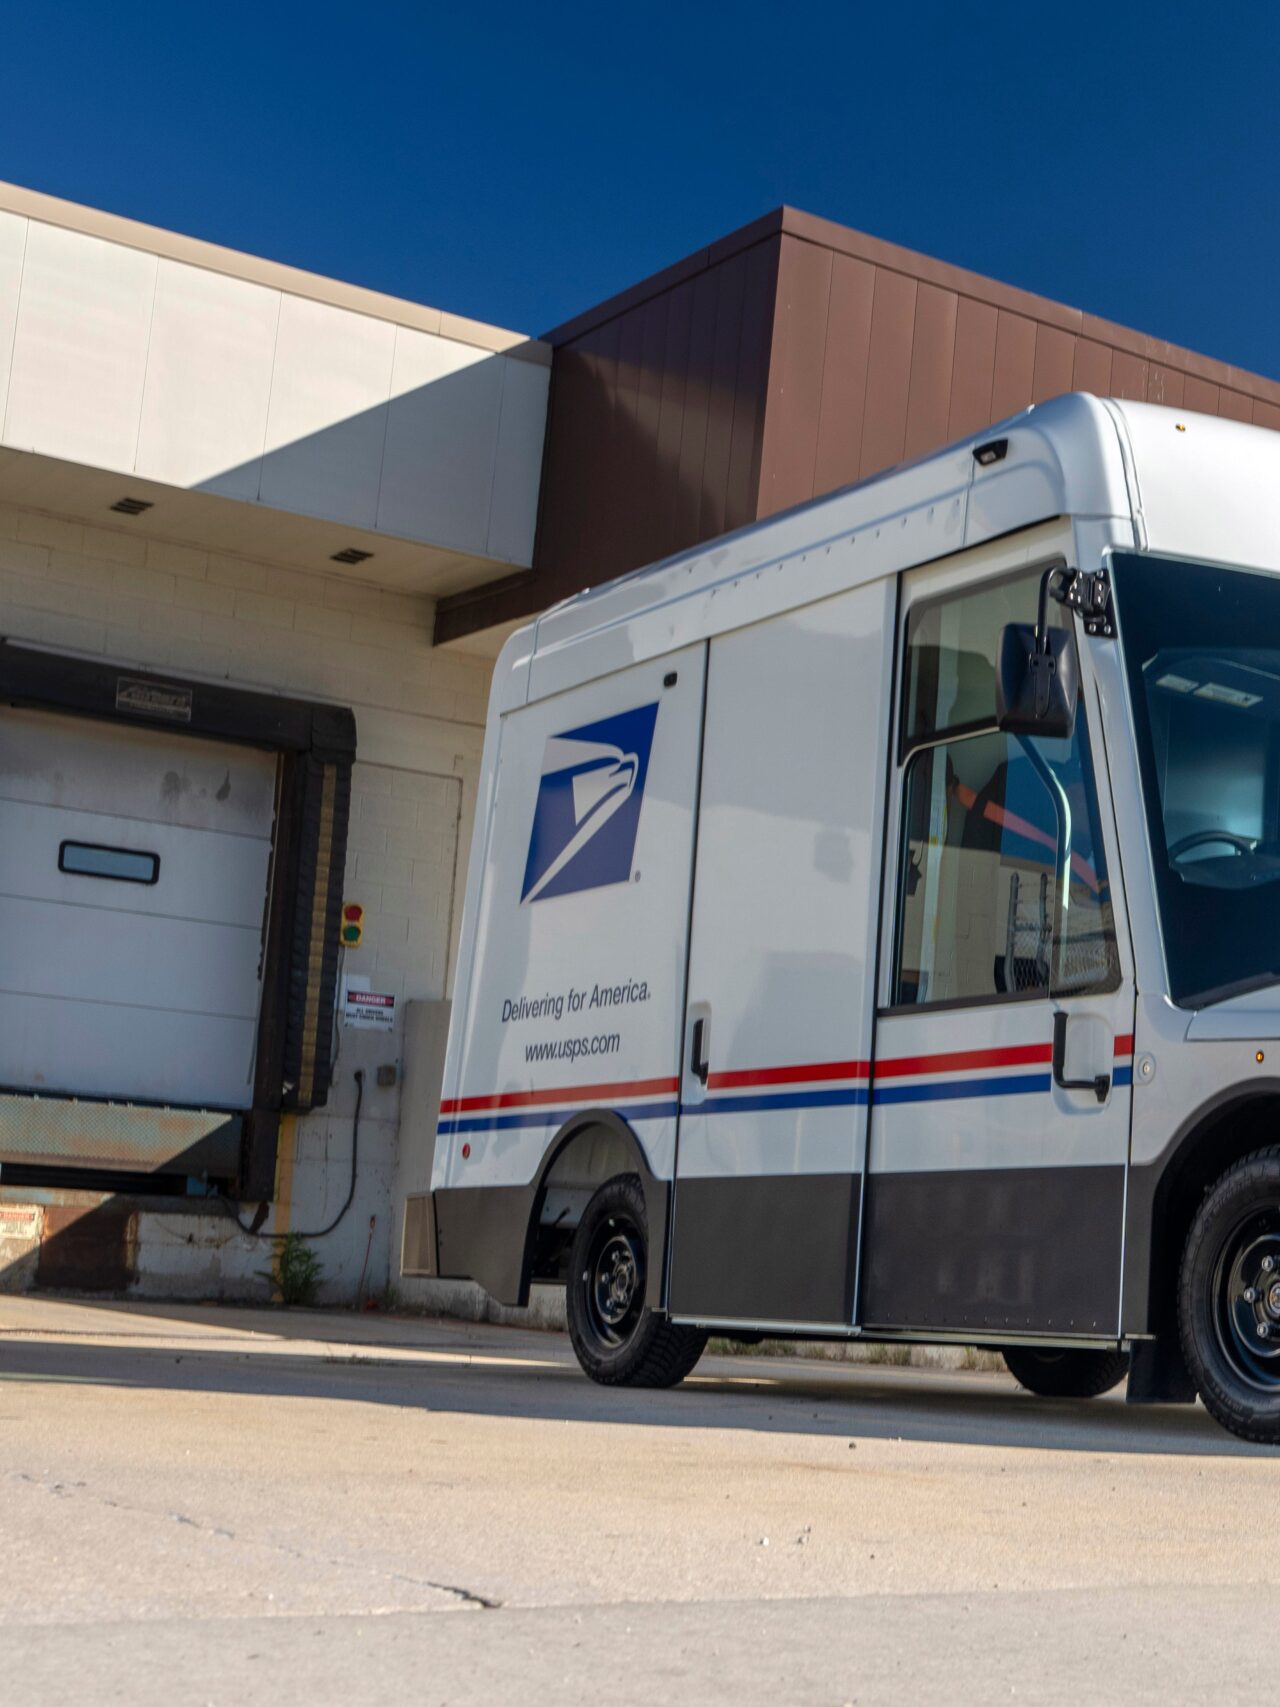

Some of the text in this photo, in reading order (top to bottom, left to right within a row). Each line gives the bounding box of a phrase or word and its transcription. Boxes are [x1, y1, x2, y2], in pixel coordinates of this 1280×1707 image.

[356, 994, 386, 1005] DANGER
[501, 992, 564, 1023] Delivering
[567, 987, 587, 1013] for
[525, 1032, 620, 1064] www.usps.com
